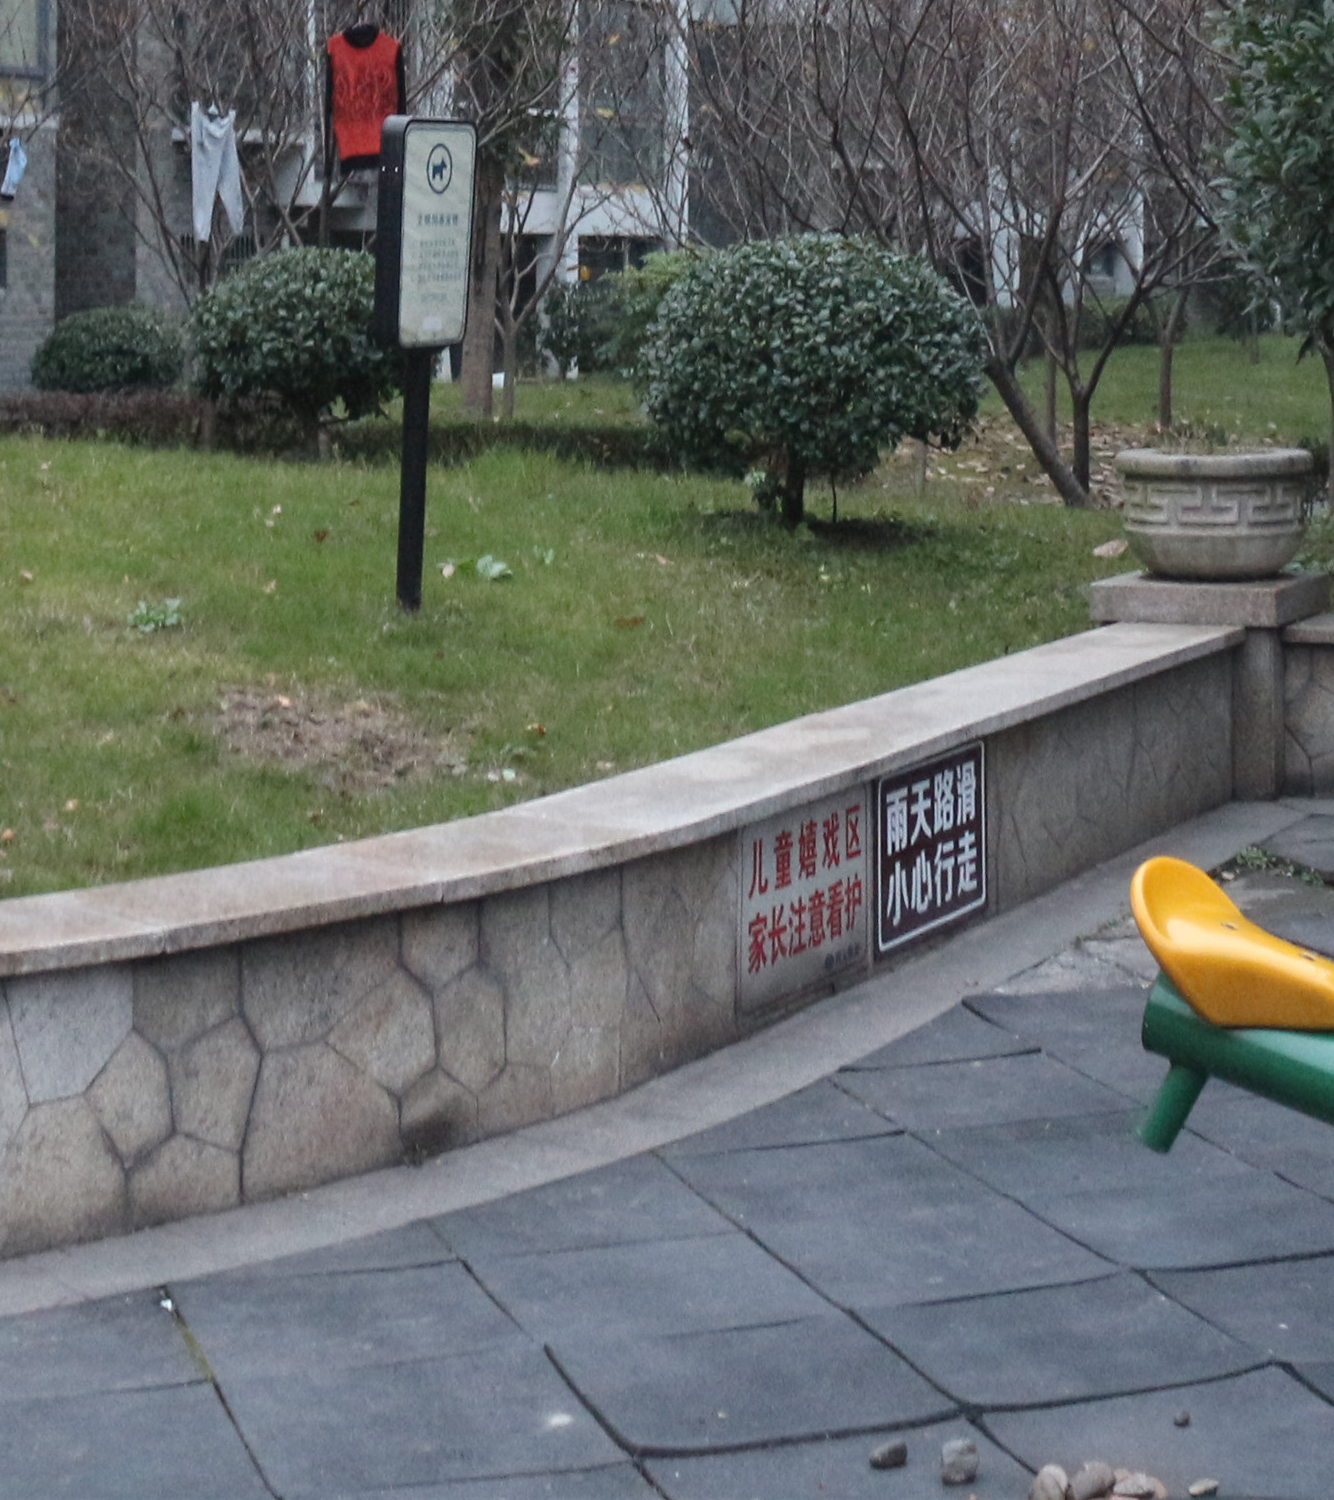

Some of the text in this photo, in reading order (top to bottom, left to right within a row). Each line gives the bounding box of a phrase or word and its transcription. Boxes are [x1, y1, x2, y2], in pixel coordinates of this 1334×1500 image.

[748, 805, 862, 899] 儿童嬉戏区
[885, 761, 977, 856] 雨天路滑
[748, 872, 863, 974] 家长注意看护
[886, 830, 978, 927] 小心行走
